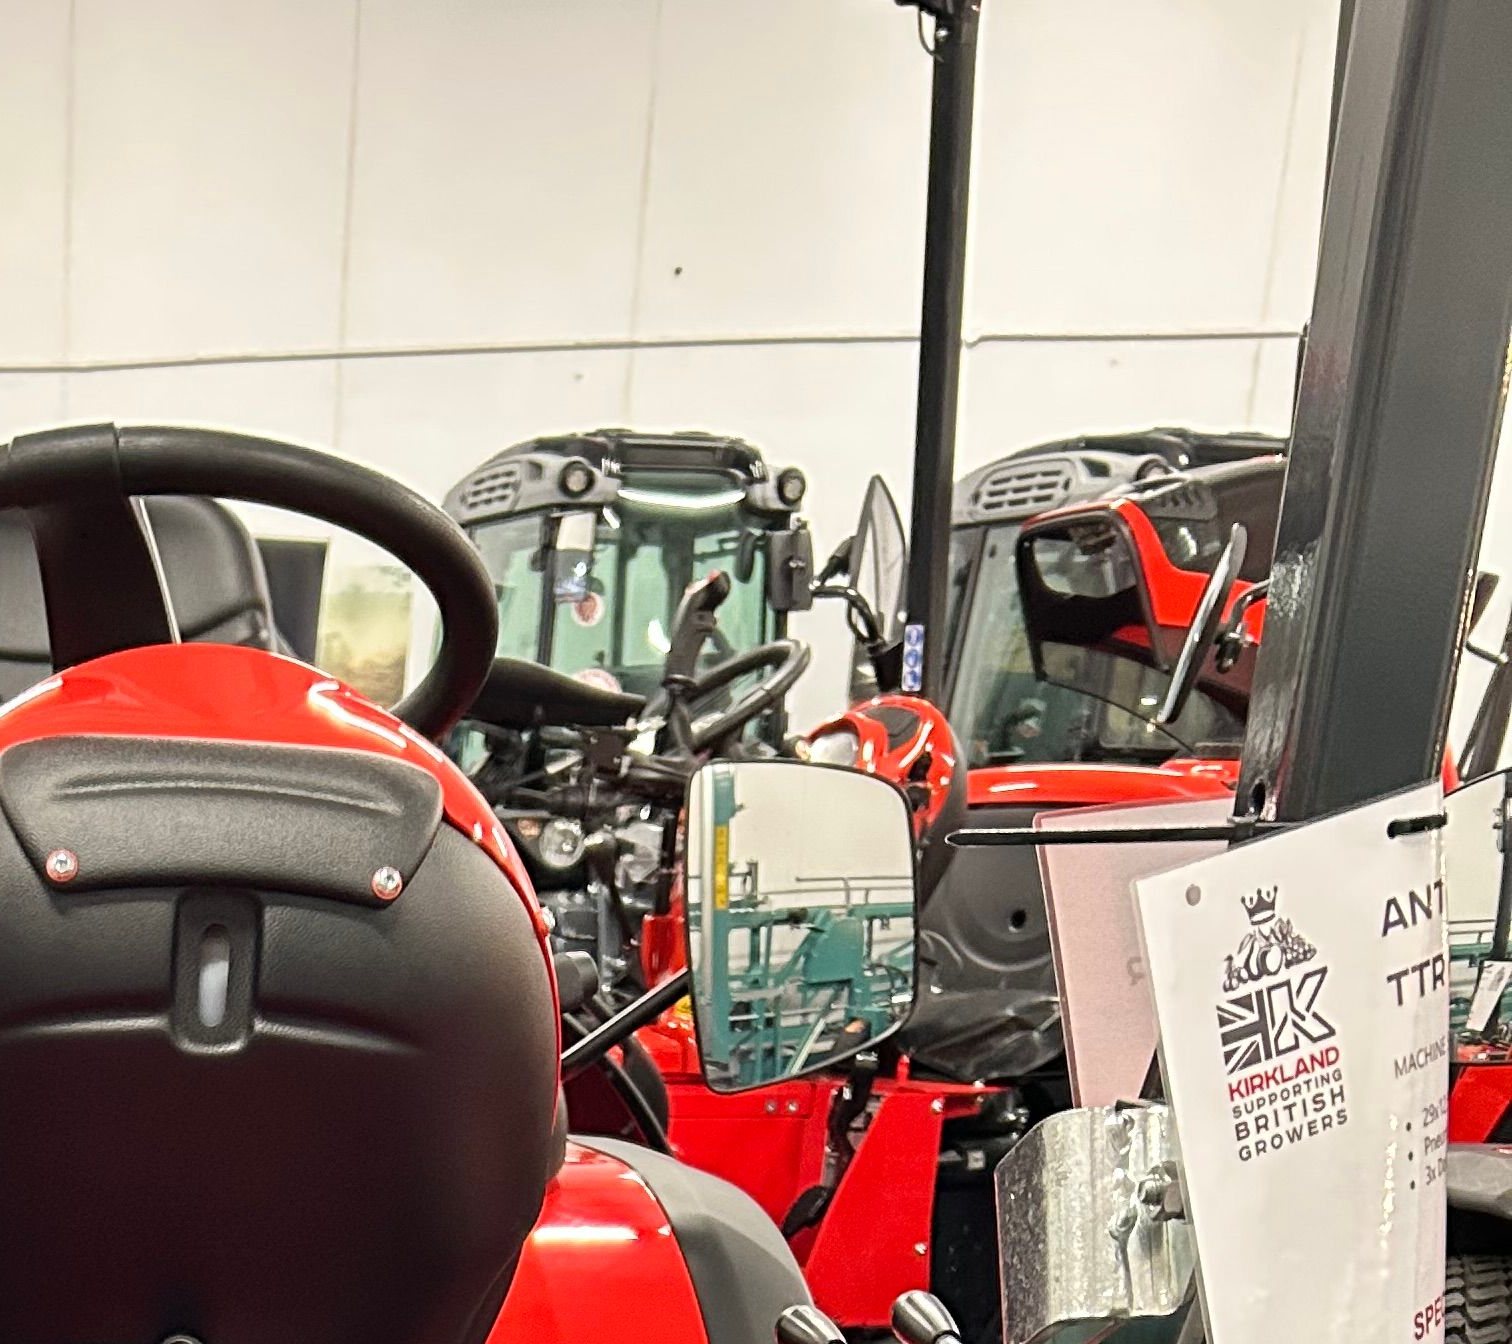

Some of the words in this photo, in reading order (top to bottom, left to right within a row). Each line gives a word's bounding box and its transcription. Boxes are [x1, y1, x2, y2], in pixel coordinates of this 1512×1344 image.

[1228, 1046, 1340, 1102] KIRKLAND
[1232, 1068, 1343, 1119] SUPPORTING
[1235, 1085, 1346, 1141] BRITISH
[1239, 1109, 1348, 1161] GROWERS
